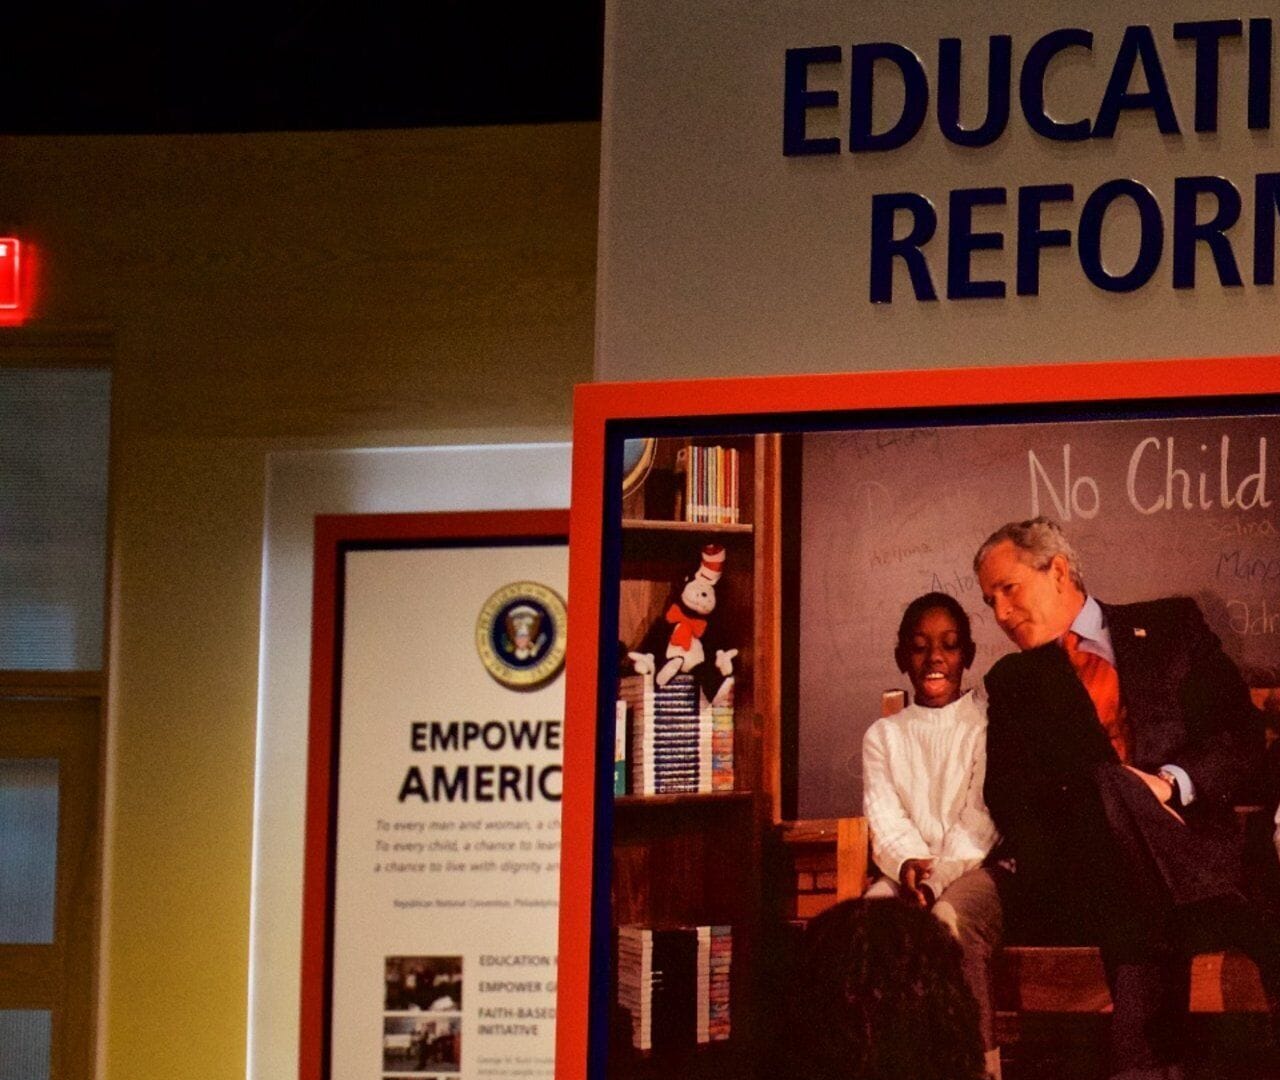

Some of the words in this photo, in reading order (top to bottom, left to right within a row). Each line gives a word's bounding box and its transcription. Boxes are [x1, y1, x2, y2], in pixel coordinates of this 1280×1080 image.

[1028, 443, 1100, 522] No
[1126, 435, 1272, 515] Child
[411, 720, 561, 752] EMPOWE
